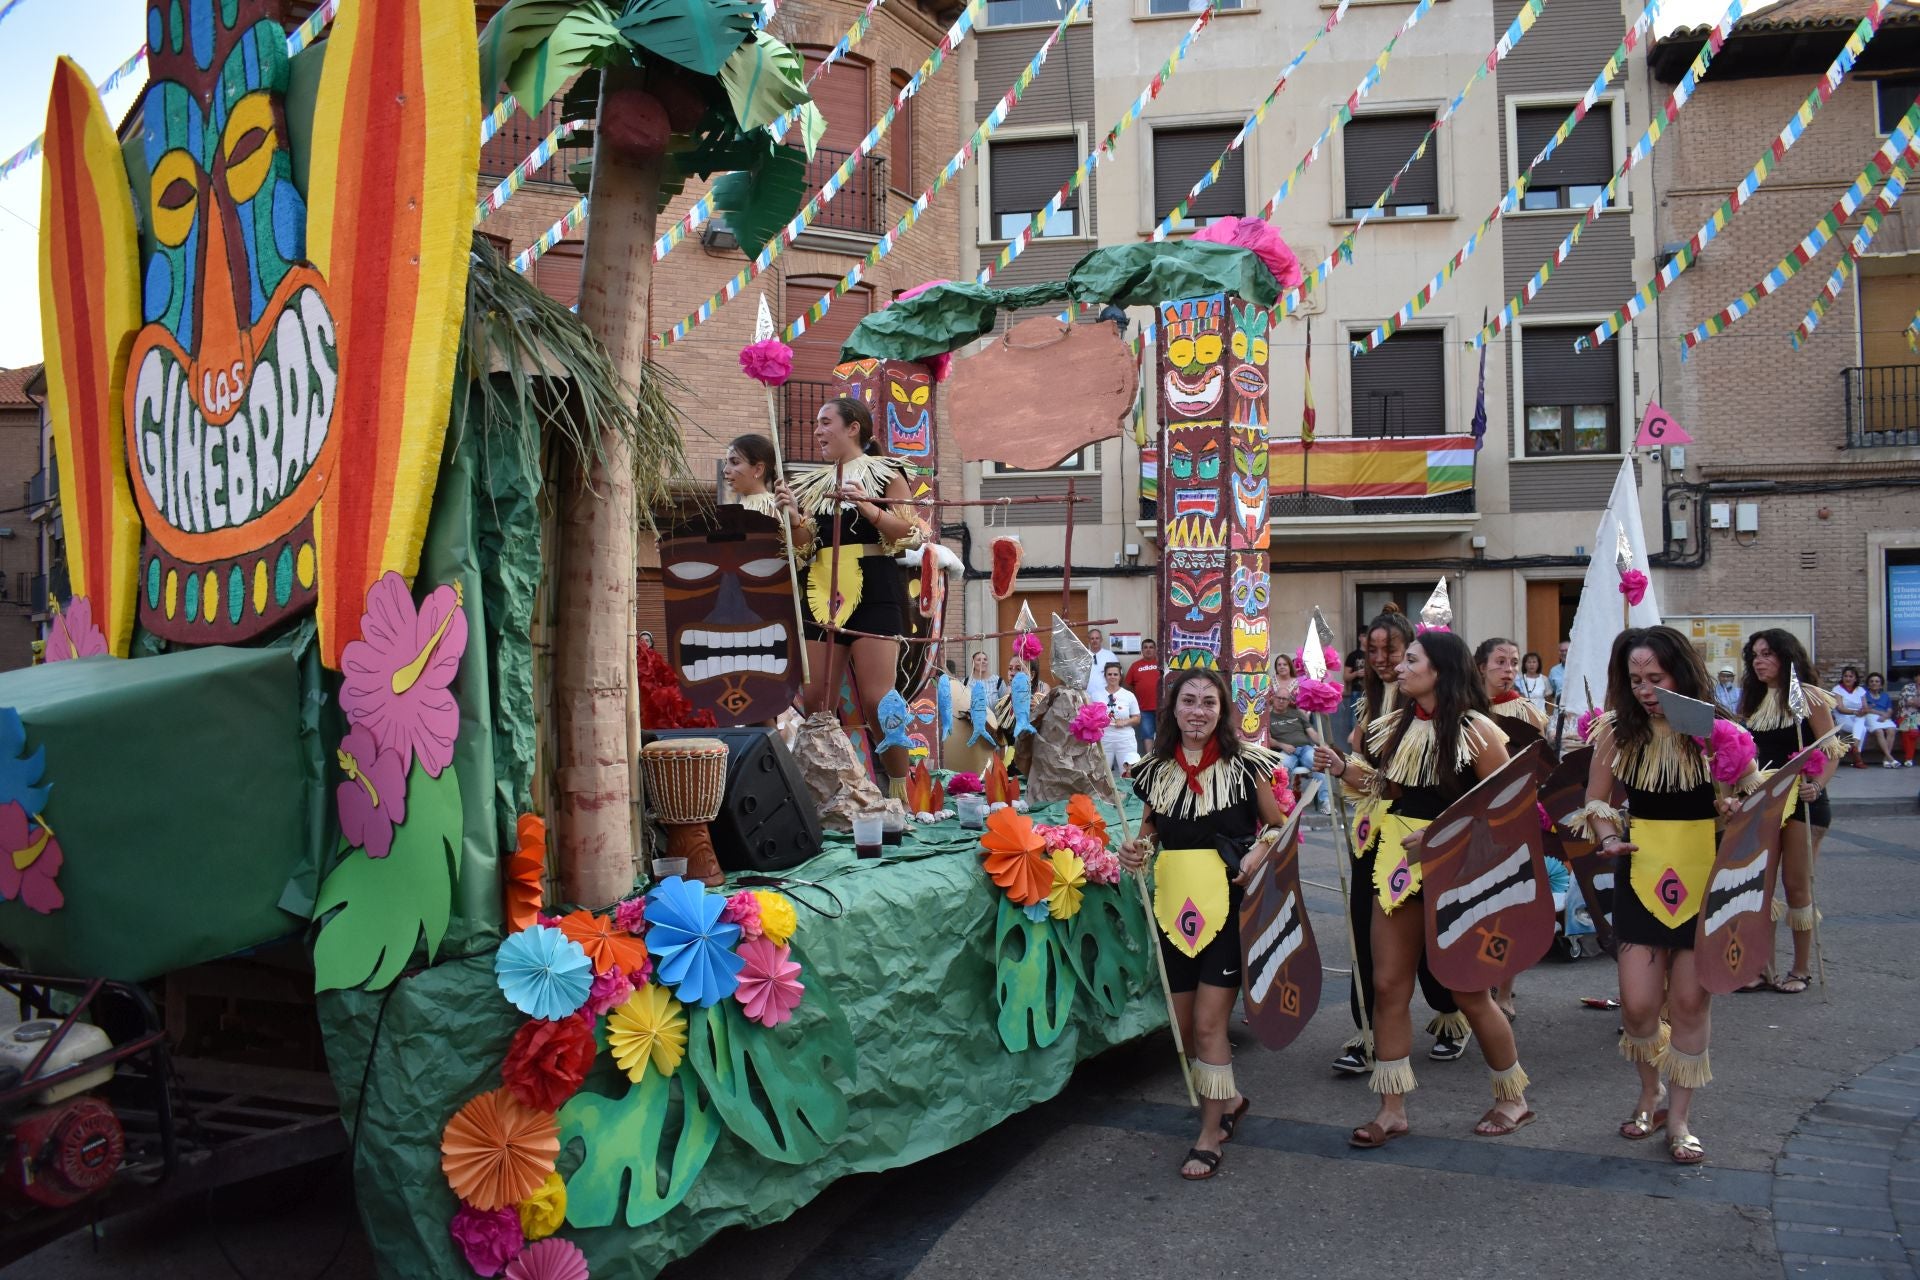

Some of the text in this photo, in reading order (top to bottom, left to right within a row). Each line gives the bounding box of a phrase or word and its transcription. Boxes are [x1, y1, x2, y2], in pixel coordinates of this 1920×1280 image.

[203, 361, 245, 415] LAS
[136, 287, 337, 534] GINEBRAS
[1648, 417, 1667, 438] G
[727, 693, 743, 710] G
[1359, 819, 1370, 841] G
[1390, 867, 1406, 893] G
[1662, 878, 1678, 905] G
[1180, 910, 1197, 937] G
[1488, 937, 1505, 957] G
[1728, 943, 1739, 966] G
[1284, 988, 1297, 1011] G
